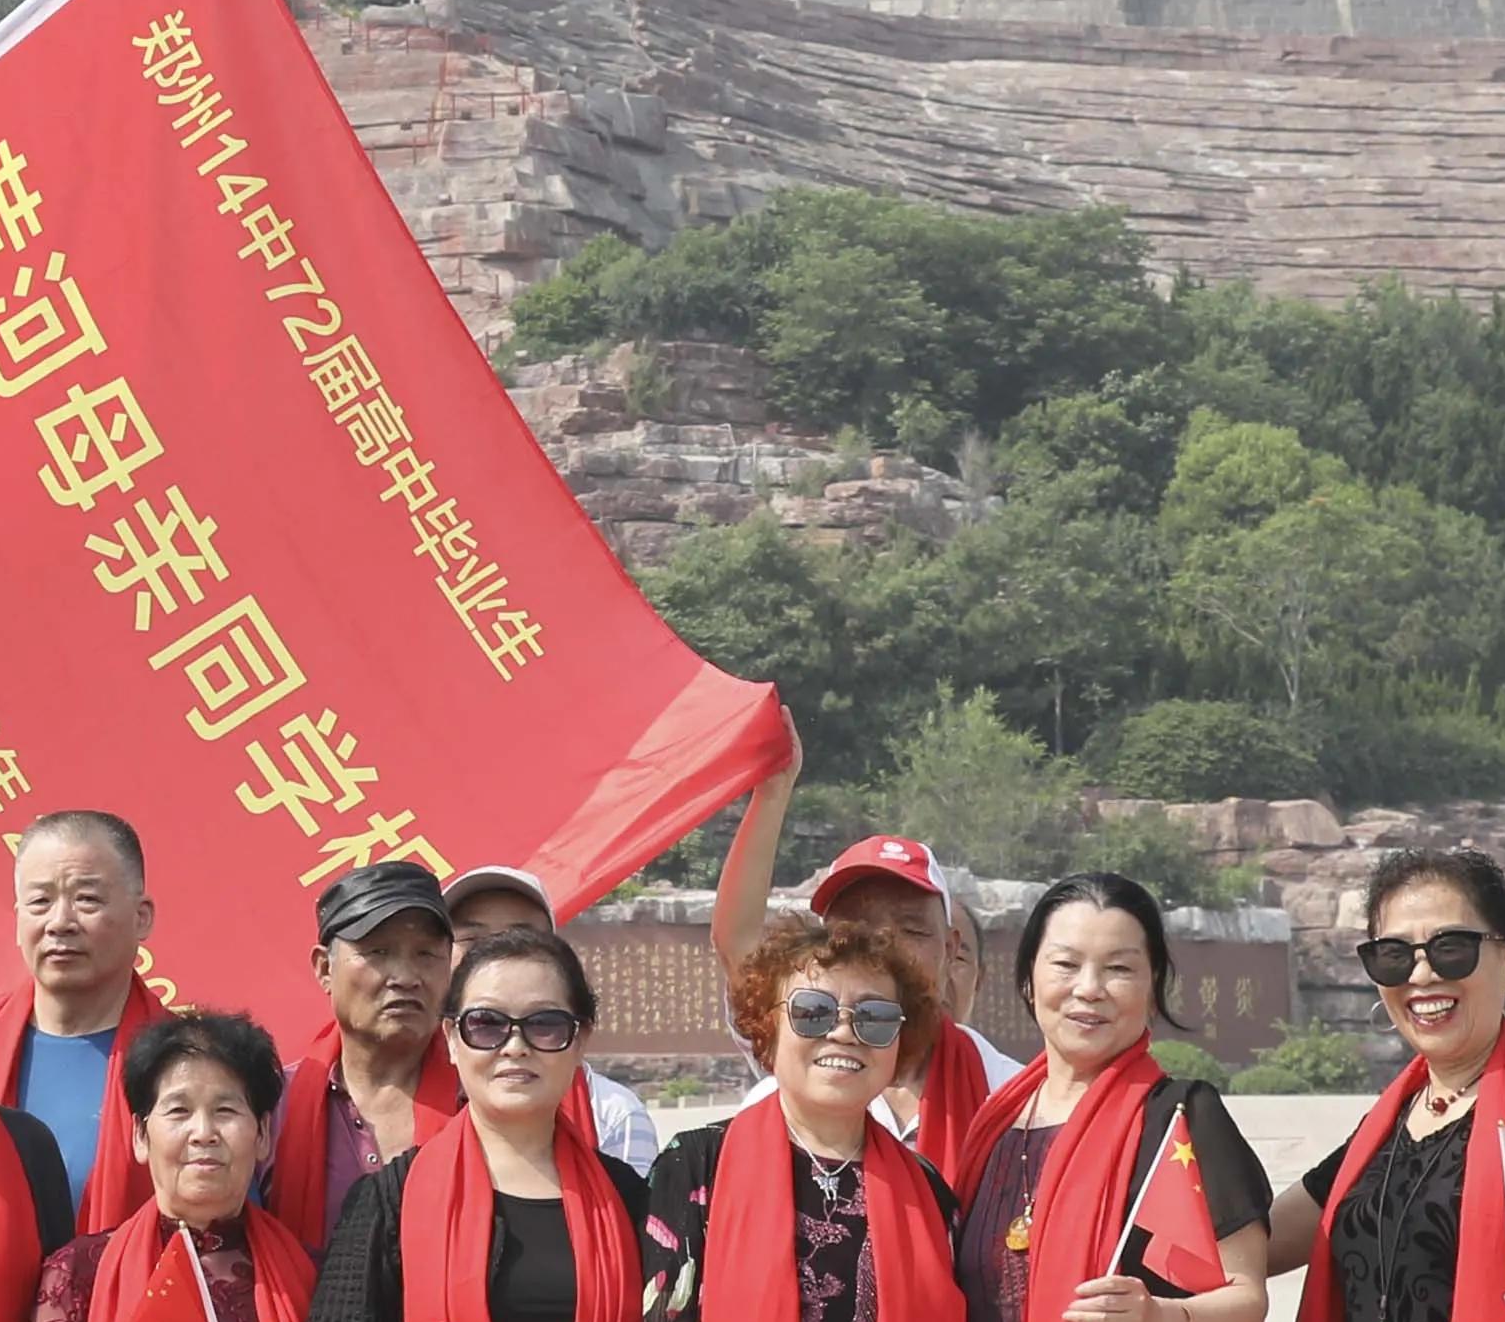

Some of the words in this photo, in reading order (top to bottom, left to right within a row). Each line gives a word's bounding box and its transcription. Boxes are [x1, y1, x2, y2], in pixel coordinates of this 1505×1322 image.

[131, 9, 545, 682] 郑州14中72届高中毕业生
